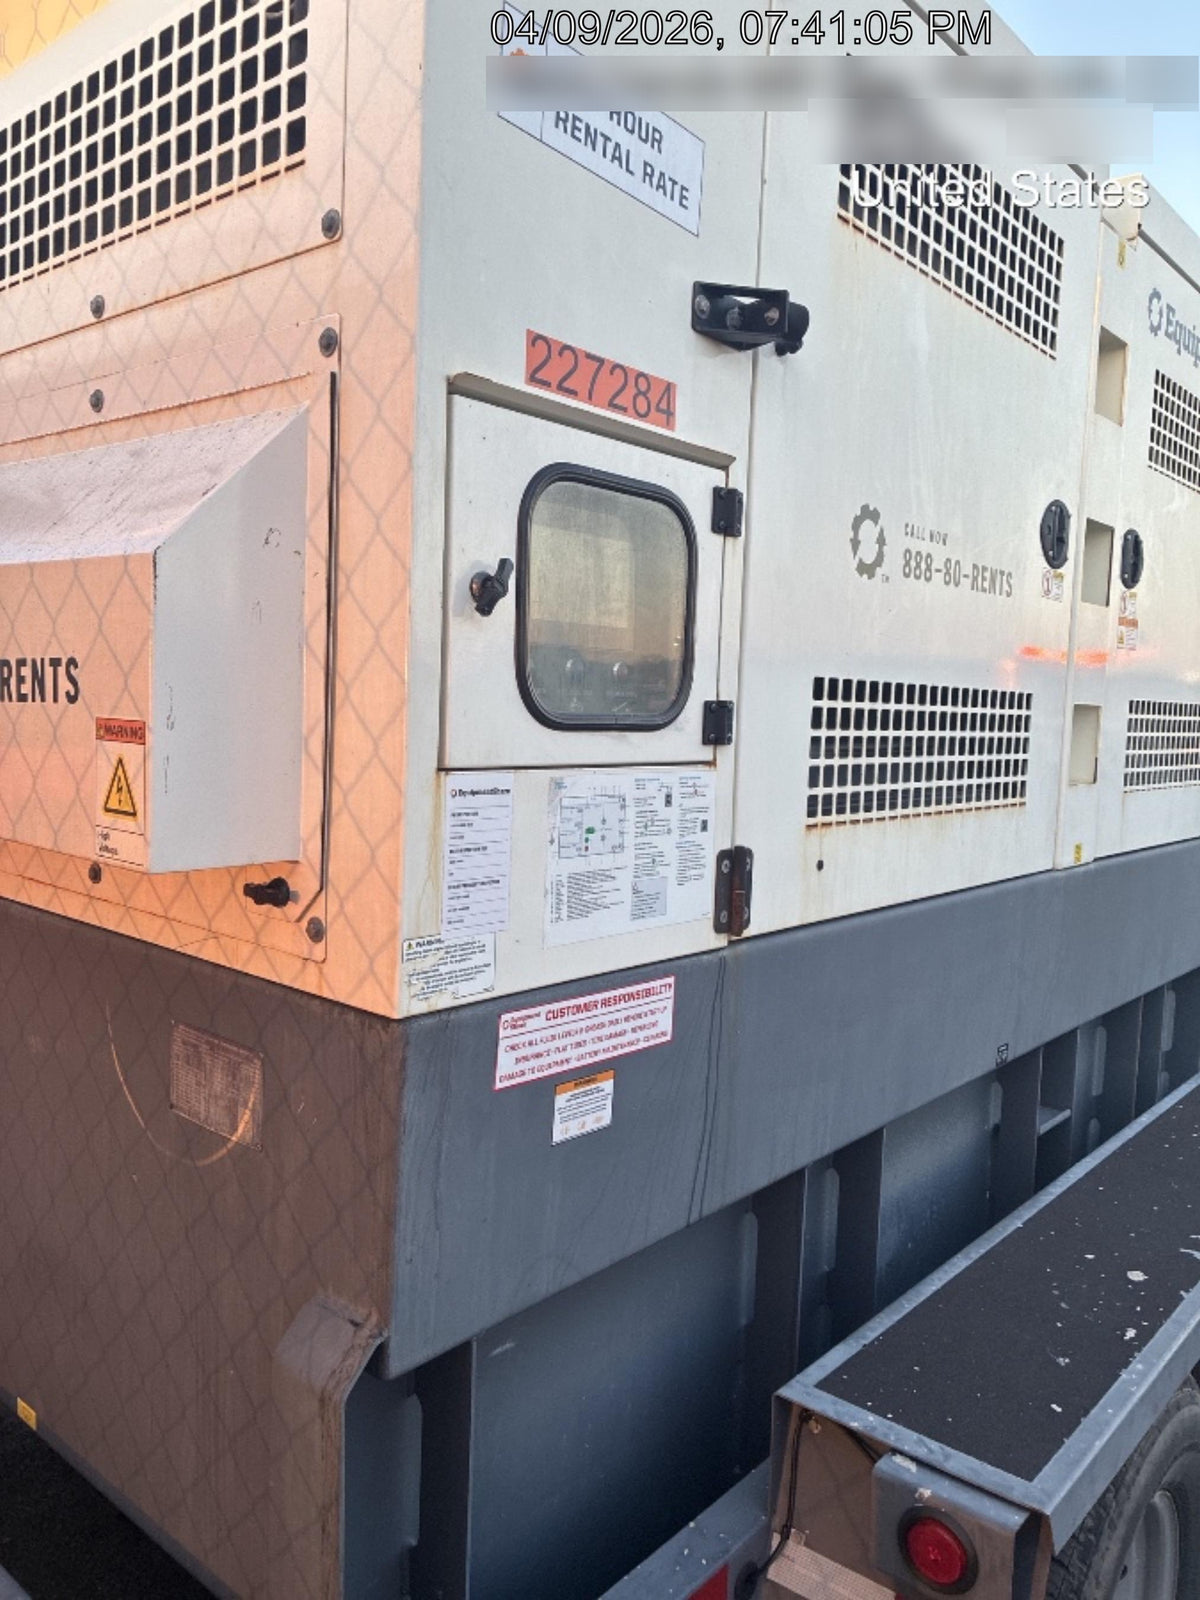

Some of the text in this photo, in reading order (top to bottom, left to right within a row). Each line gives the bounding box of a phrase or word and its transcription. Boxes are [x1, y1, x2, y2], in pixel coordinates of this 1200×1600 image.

[554, 111, 690, 210] RENTAL RATE
[528, 333, 674, 427] 227284
[904, 522, 949, 546] CALL NOW
[902, 547, 1013, 598] 888-80-RENTS
[104, 722, 145, 741] WARNING
[545, 983, 673, 1021] CUSTOMER RESPONSIBILITY
